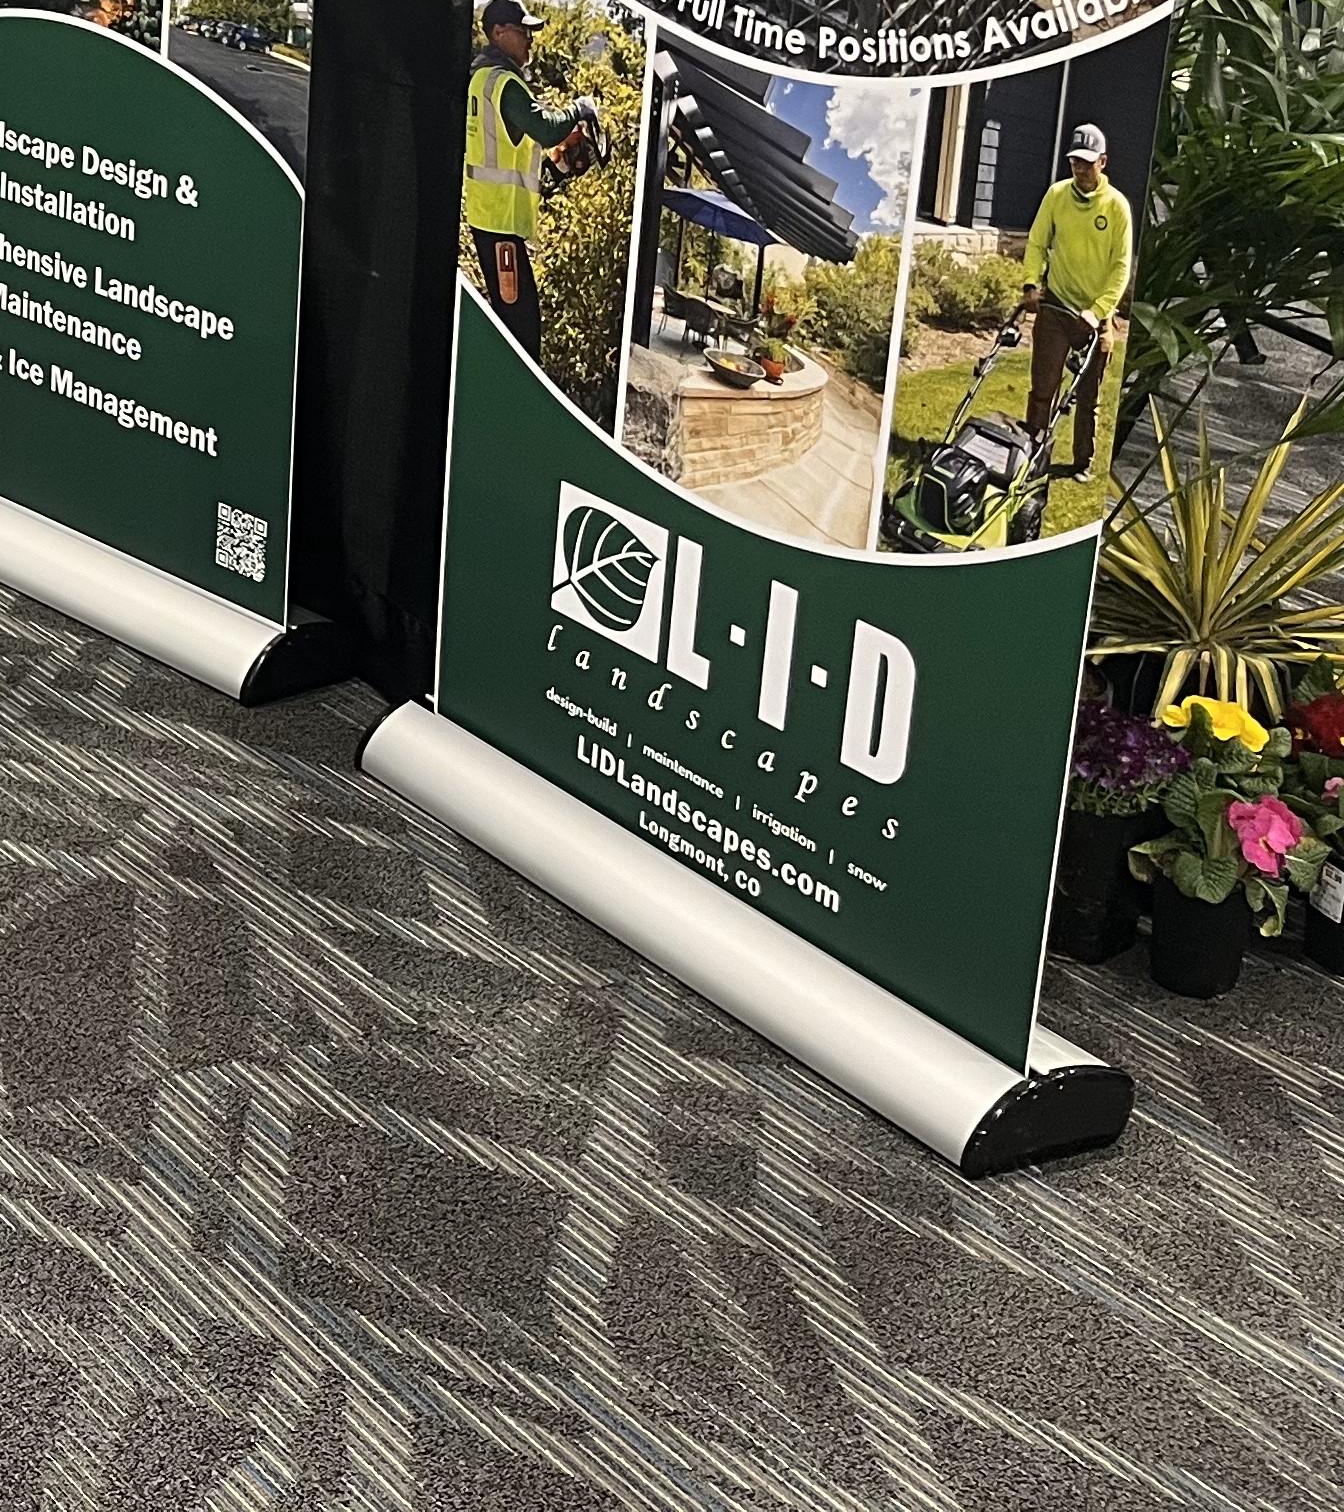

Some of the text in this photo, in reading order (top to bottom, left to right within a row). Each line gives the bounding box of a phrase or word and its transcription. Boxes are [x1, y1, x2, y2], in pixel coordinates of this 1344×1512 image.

[733, 3, 807, 56] Time
[818, 26, 971, 64] Positions
[0, 171, 136, 242] Installation
[81, 145, 168, 201] Design
[175, 174, 199, 207] &
[94, 266, 235, 341] Landscape
[9, 348, 44, 386] Ice
[50, 364, 219, 457] Management
[545, 687, 888, 892] design-build maintenance irrigation snow
[577, 735, 840, 913] LIDLandscapes.com
[639, 810, 761, 897] Longmont, CO
